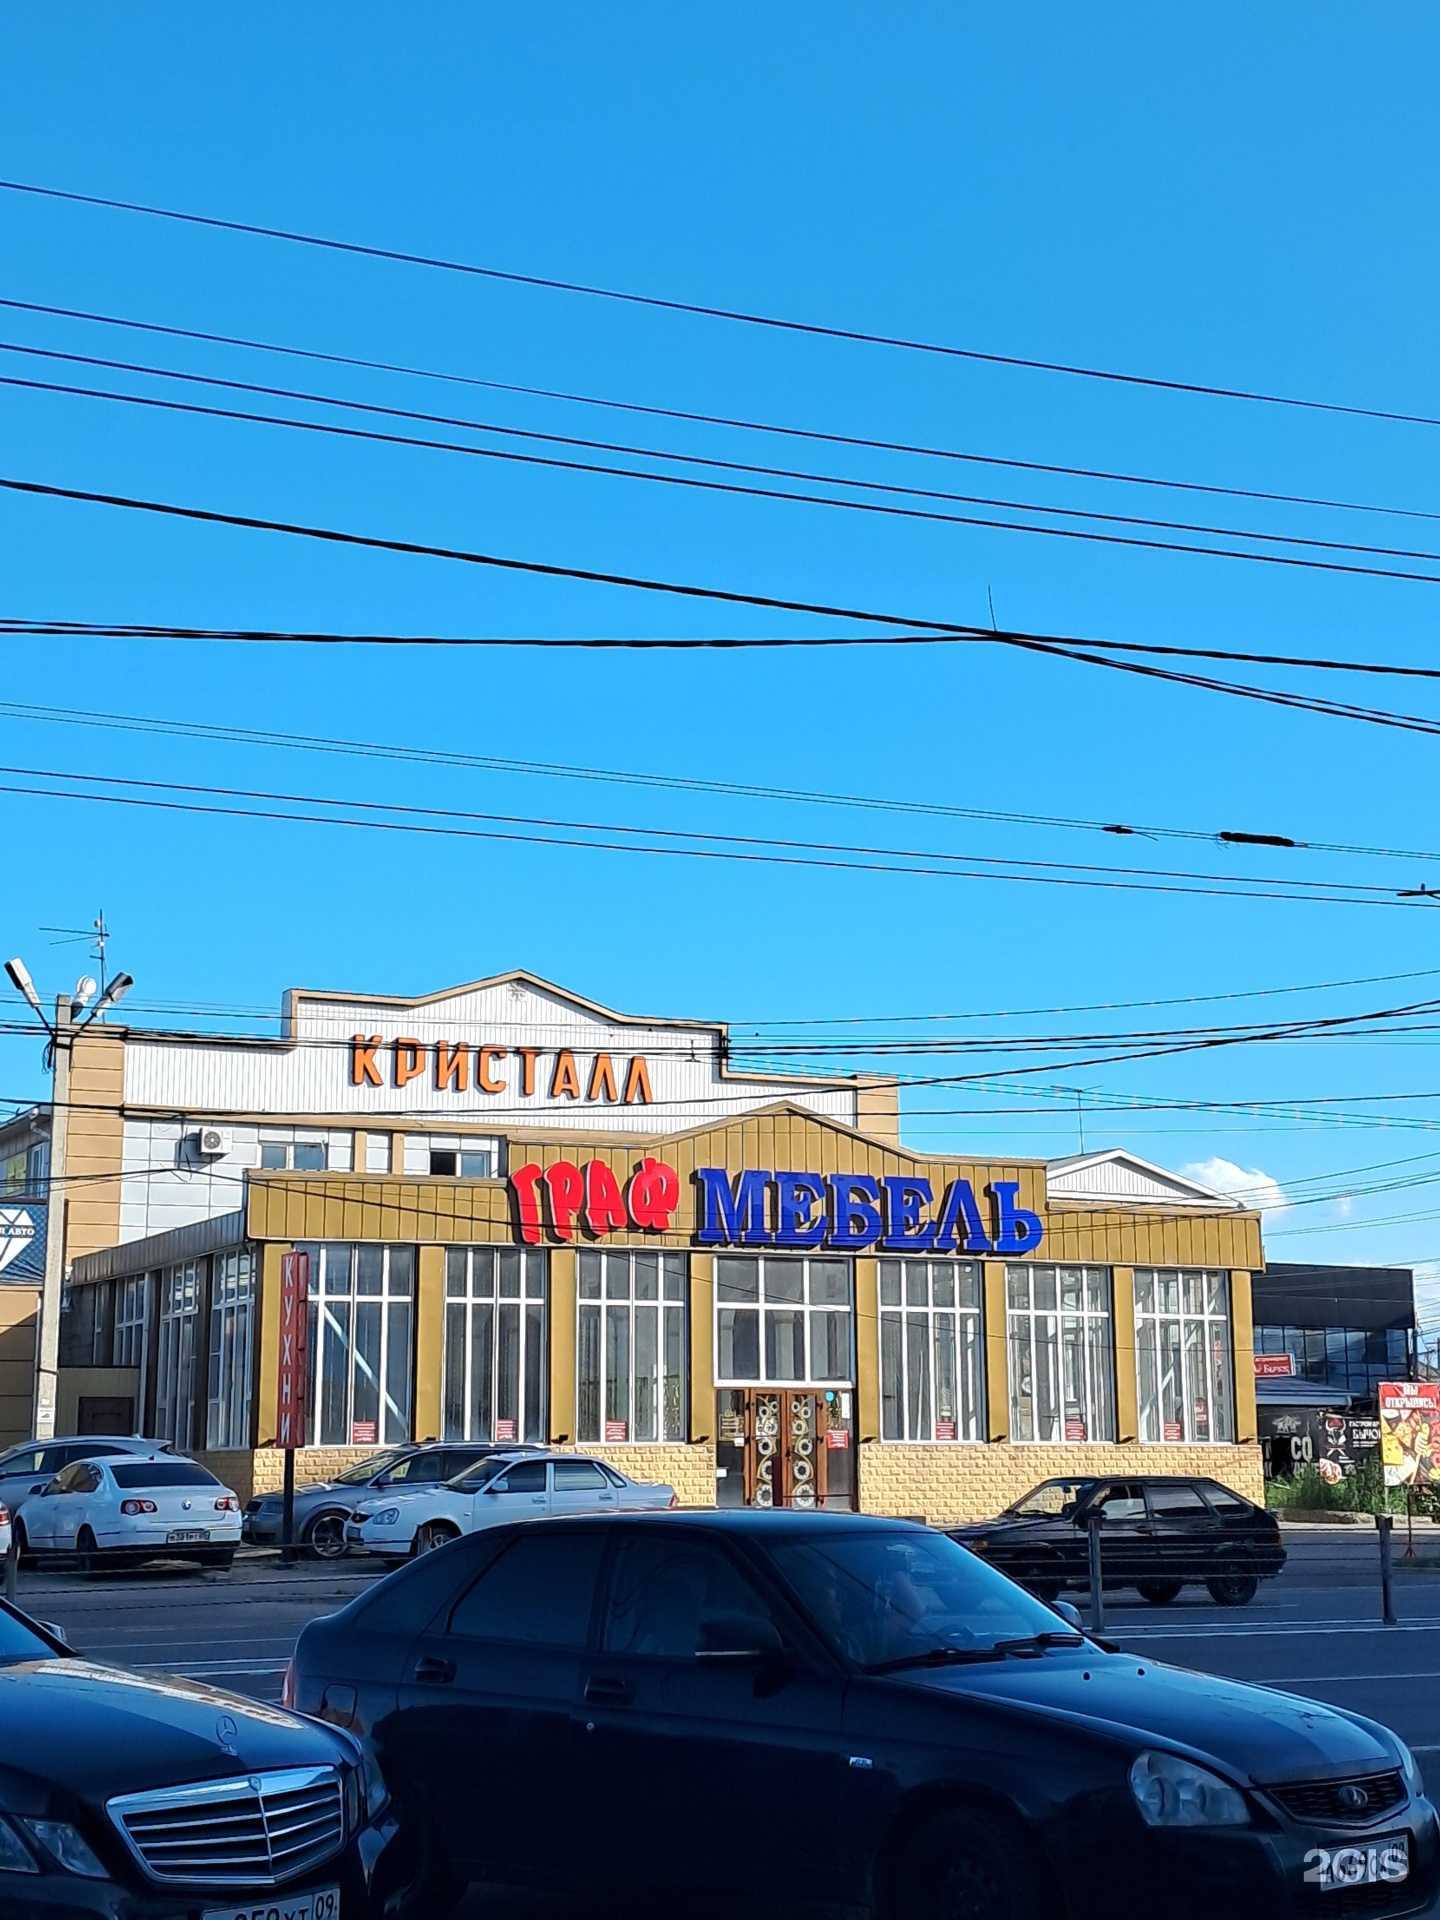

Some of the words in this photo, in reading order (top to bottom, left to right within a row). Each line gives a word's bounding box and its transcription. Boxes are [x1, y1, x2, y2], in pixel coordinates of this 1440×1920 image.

[351, 1034, 654, 1104] КРИСТАЛЛ
[8, 1227, 36, 1236] АВТО
[510, 1157, 680, 1244] ГРАФ
[693, 1168, 1044, 1255] МЕБЕЛЬ
[281, 1256, 294, 1444] КУХНИ
